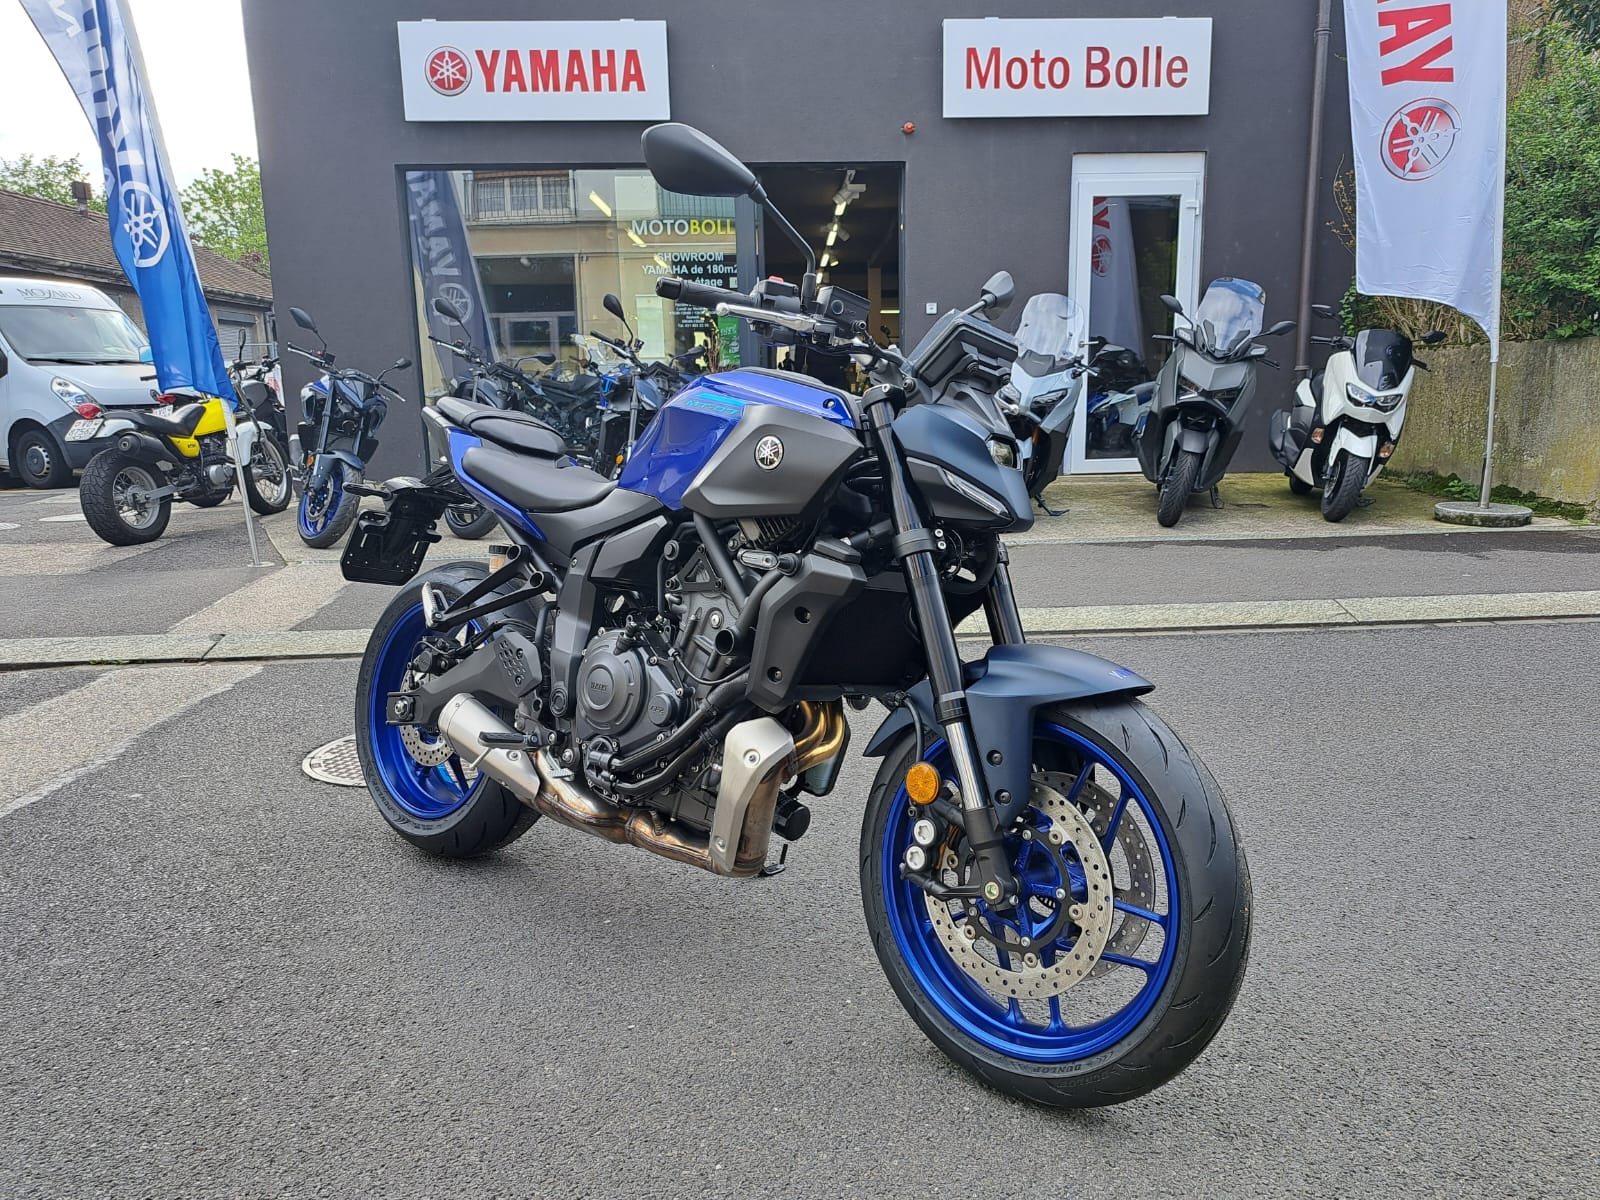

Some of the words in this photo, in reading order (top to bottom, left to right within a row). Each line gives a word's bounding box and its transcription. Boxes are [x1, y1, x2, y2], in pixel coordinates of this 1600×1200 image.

[474, 48, 647, 92] YAMAHA
[965, 47, 1071, 90] Moto
[1085, 45, 1189, 89] Bolle
[655, 252, 724, 262] SHOWROOM
[642, 264, 689, 274] YAMAHA
[690, 264, 703, 274] de
[1033, 1063, 1082, 1074] DUNLOP
